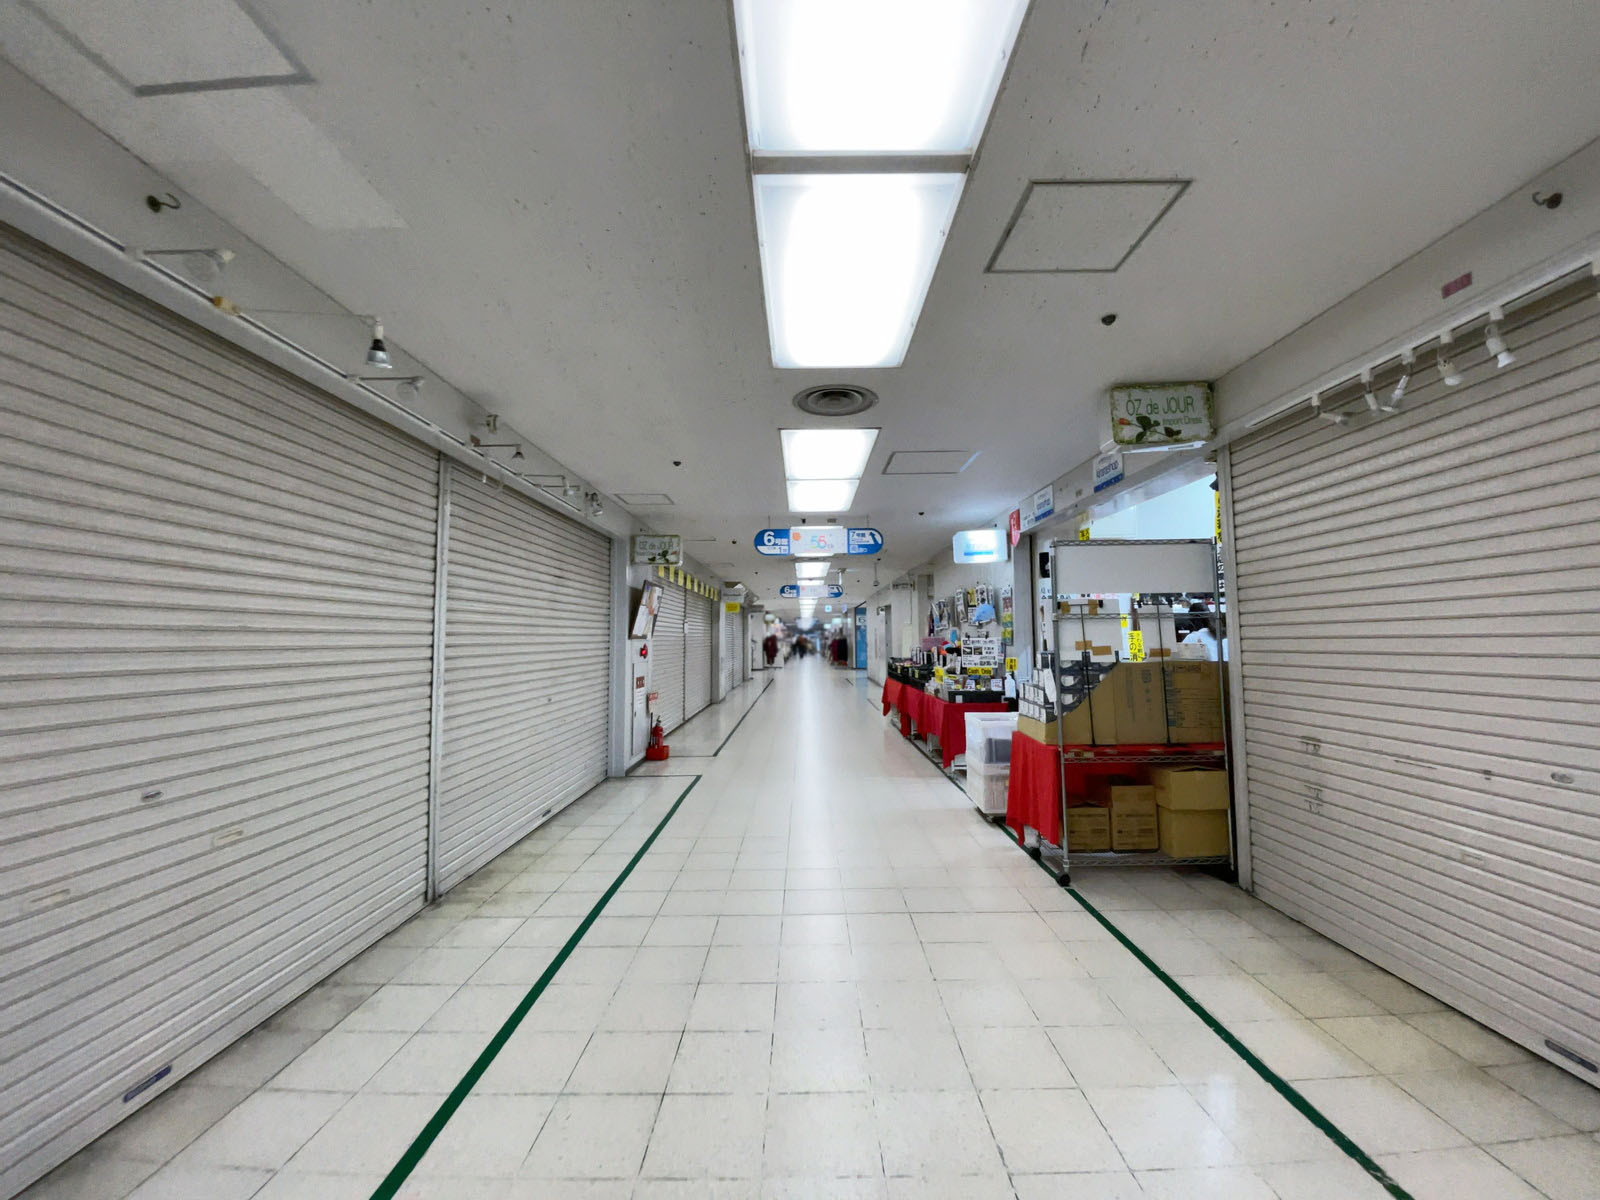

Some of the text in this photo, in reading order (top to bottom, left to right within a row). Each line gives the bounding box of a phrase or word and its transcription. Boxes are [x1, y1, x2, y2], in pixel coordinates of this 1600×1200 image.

[1125, 395, 1195, 417] OZ de JOUR
